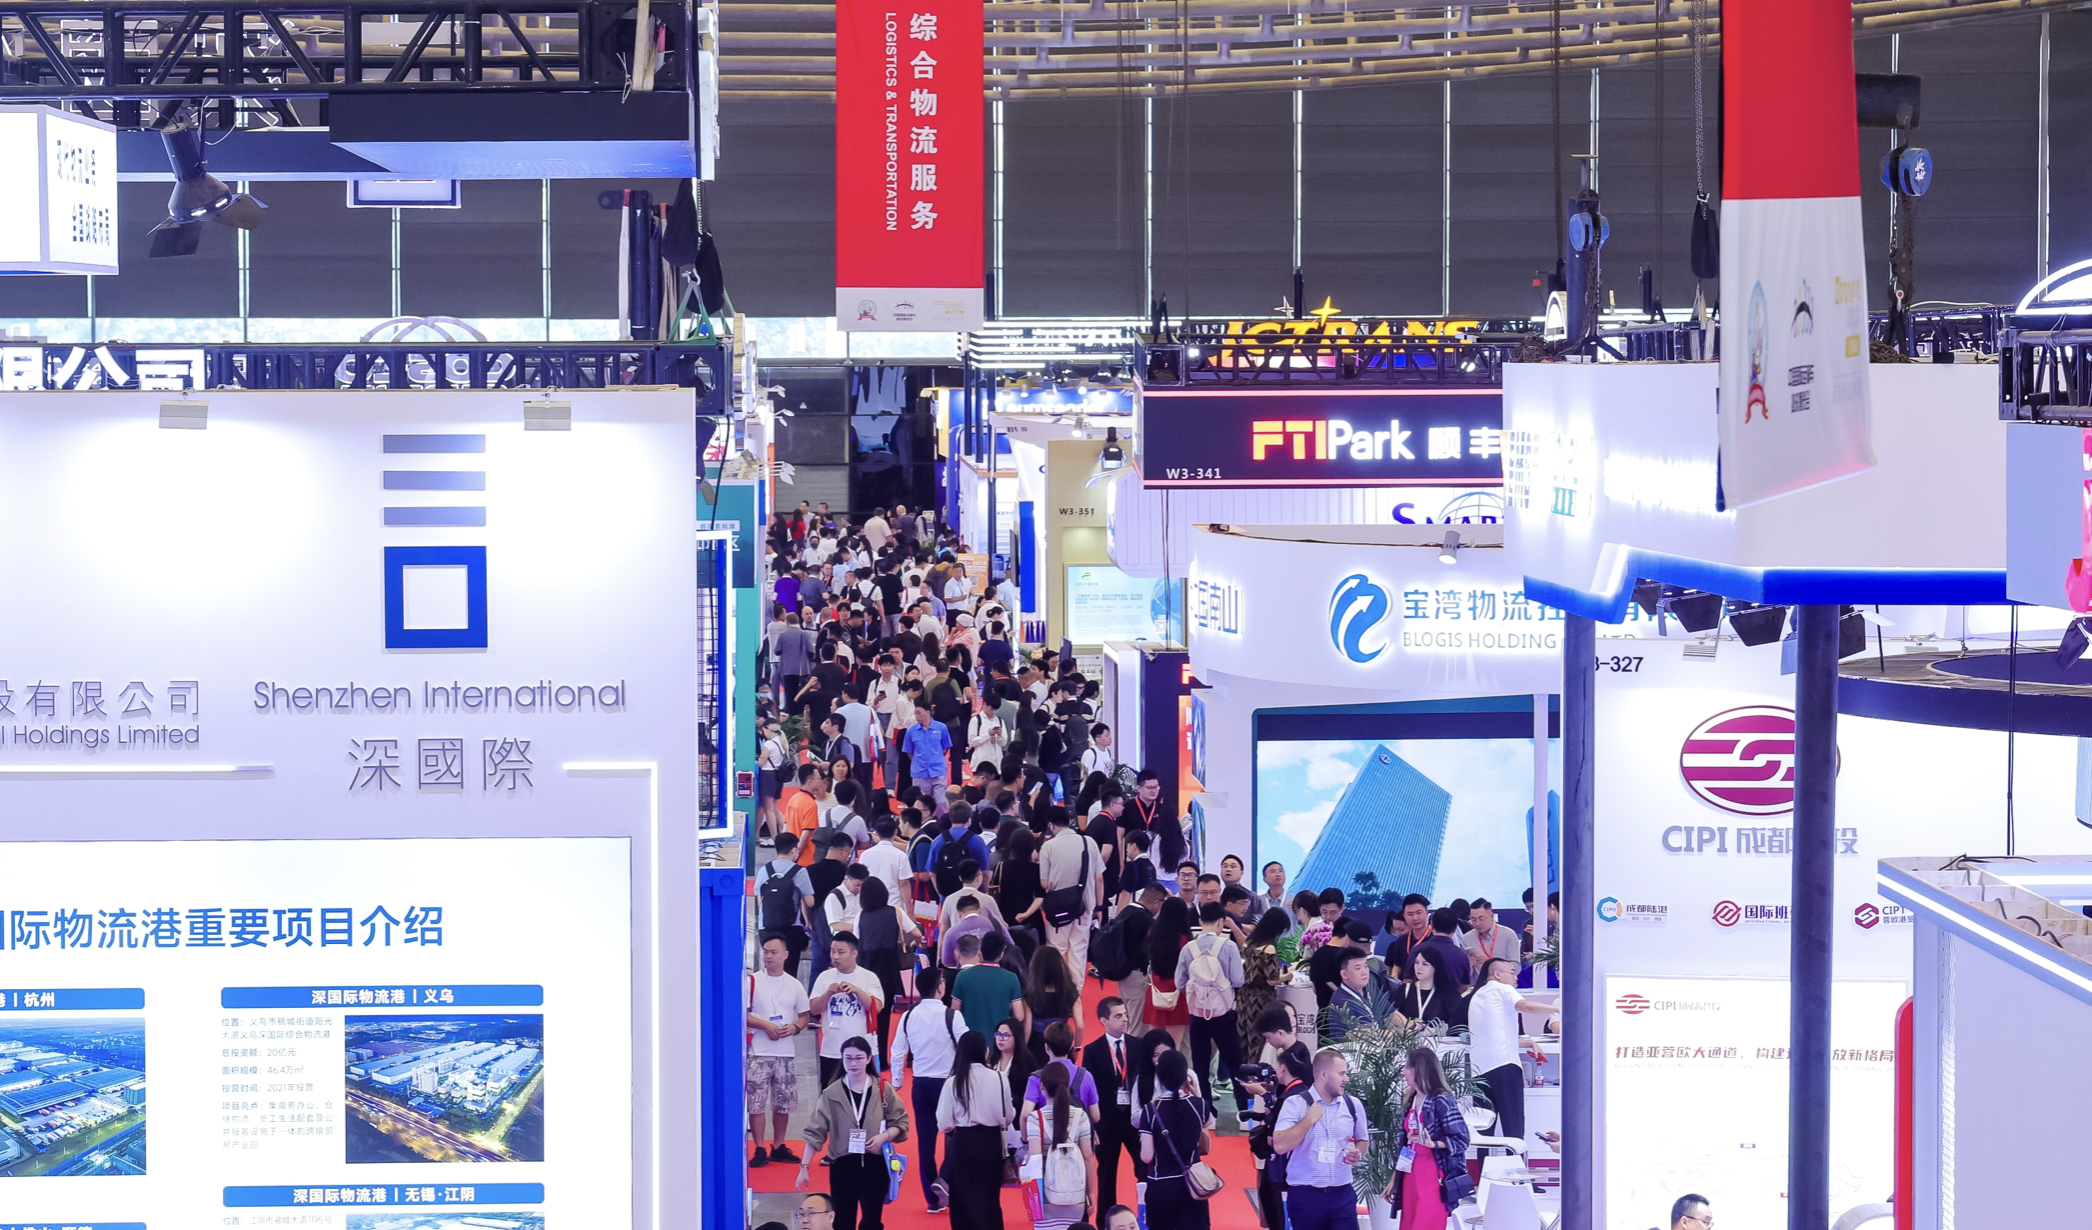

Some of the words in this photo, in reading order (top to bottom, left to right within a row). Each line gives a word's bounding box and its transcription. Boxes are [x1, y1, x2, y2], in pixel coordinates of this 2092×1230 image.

[885, 12, 897, 87] LOGISTICS
[885, 90, 898, 100] &
[909, 12, 938, 230] 综合物流服务
[885, 104, 898, 231] TRANSPORTATION
[1252, 419, 1415, 461] FTIPark
[1428, 426, 1501, 460] 顺丰
[1165, 468, 1222, 479] W3-341
[1059, 507, 1095, 516] W3-351
[1403, 631, 1462, 648] BLOGIS
[1469, 632, 1557, 649] HOLDING
[254, 680, 412, 709] Shenzhen
[424, 679, 626, 708] International
[14, 725, 110, 749] Holdings
[118, 725, 200, 744] Limited
[348, 737, 534, 791] 深國際
[1662, 826, 1728, 853] CIPI
[1744, 905, 1792, 920] 国际班
[0, 905, 443, 950] 际物流港重要项目介绍
[1654, 1001, 1677, 1011] CIPI
